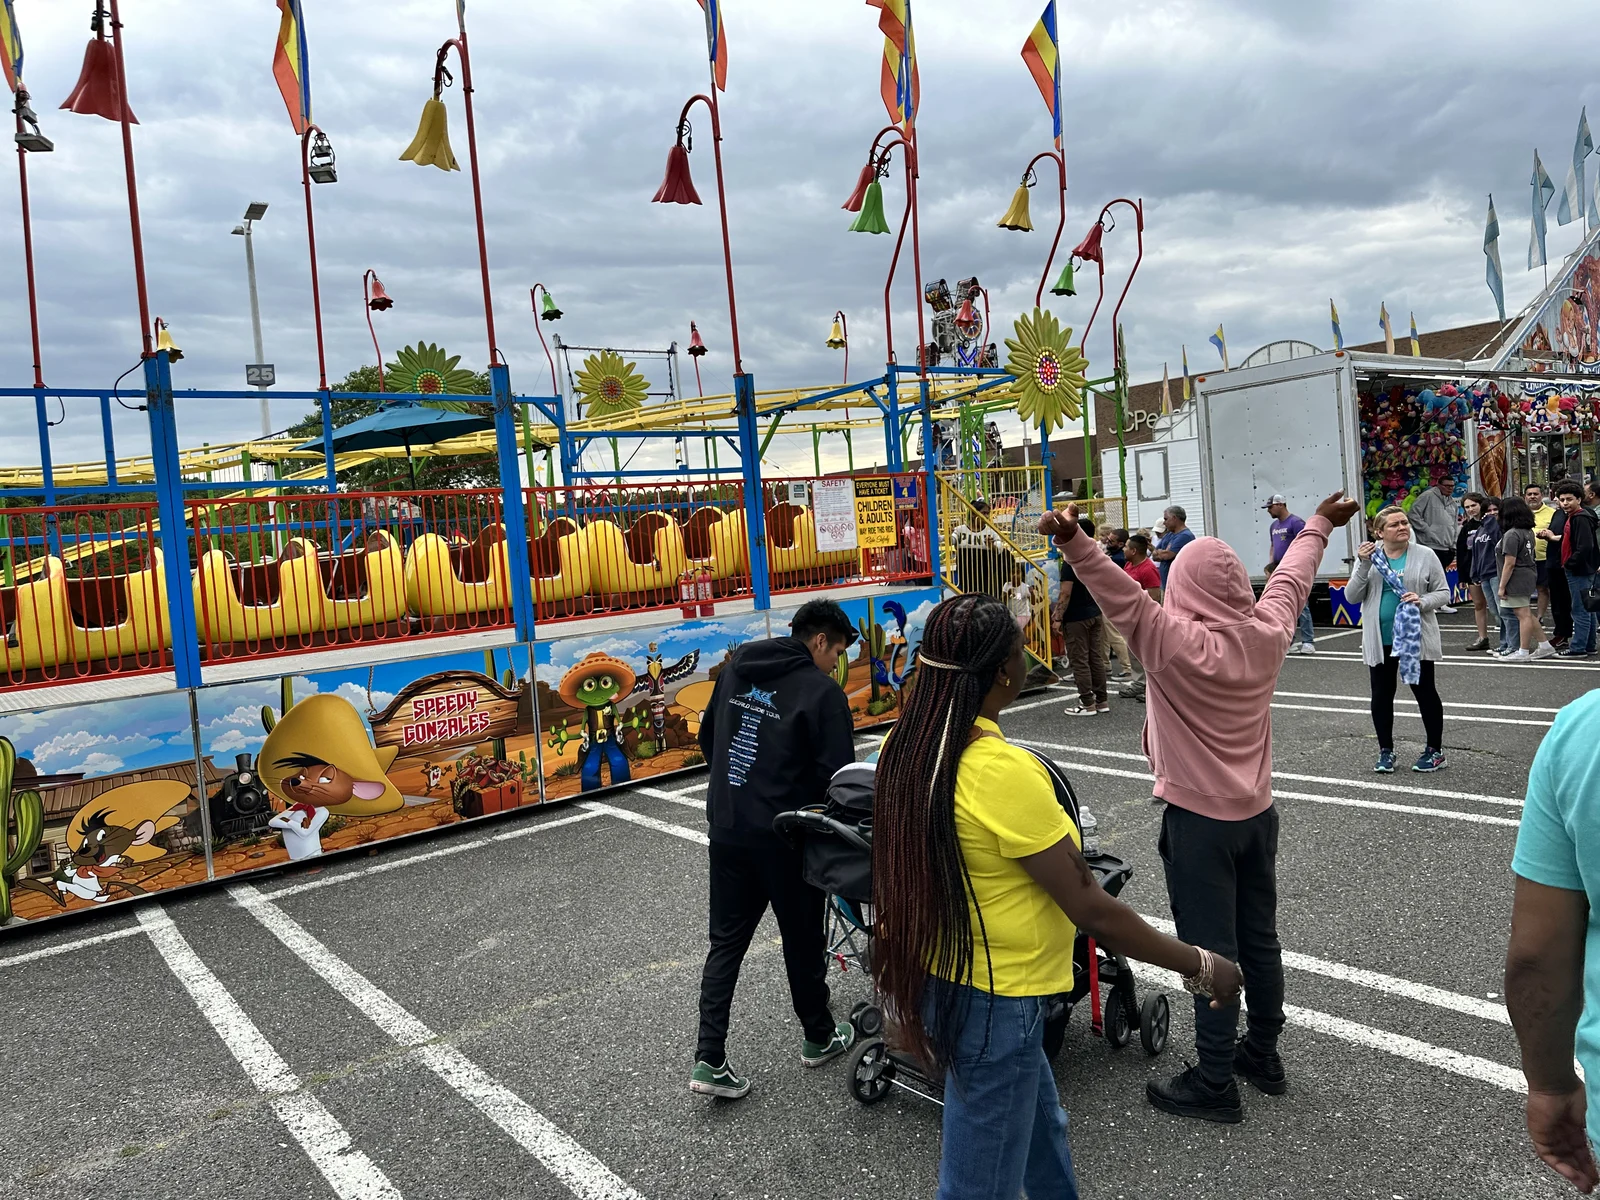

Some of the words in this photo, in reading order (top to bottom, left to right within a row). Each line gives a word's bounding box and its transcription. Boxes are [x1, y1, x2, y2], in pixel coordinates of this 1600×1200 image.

[247, 367, 274, 382] 25
[901, 487, 909, 497] 4
[857, 500, 893, 513] CHILDREN
[858, 514, 865, 524] &
[866, 511, 893, 524] ADULTS
[868, 526, 877, 534] RIDE
[413, 690, 478, 718] SPEEDY
[766, 710, 781, 720] TOUR
[403, 712, 490, 746] GONZALES
